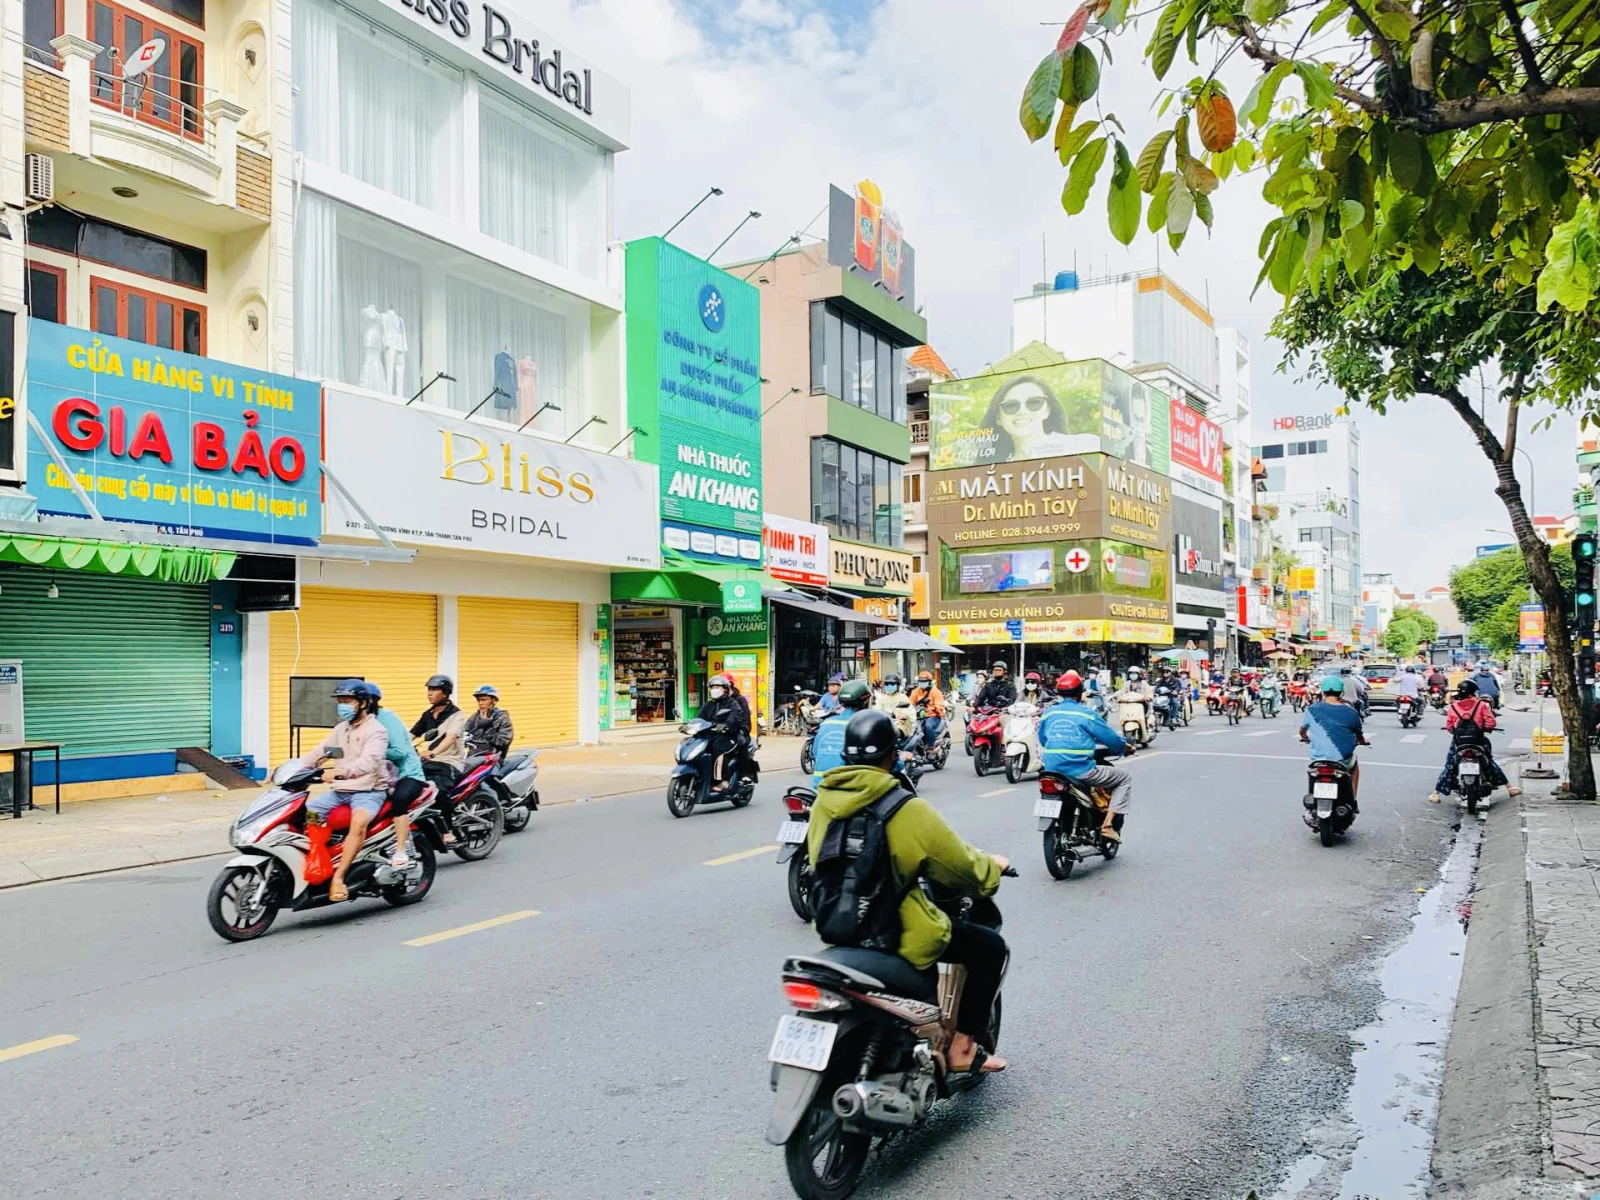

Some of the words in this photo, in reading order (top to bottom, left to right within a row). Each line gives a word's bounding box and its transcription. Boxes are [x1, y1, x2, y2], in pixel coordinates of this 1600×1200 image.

[482, 3, 593, 115] Bridal
[67, 340, 125, 378] CỬA
[133, 356, 203, 393] HÀNG
[211, 375, 234, 399] VI
[242, 378, 293, 411] TÍNH
[1273, 412, 1334, 431] HDBank
[52, 397, 174, 465] GIA
[193, 409, 306, 483] BẢO
[1199, 420, 1224, 476] 0%
[438, 428, 595, 504] Bliss
[677, 444, 707, 468] NHÀ
[707, 452, 751, 478] THUỐC
[130, 473, 150, 502] cấp
[153, 479, 177, 505] máy
[231, 488, 255, 511] thiết
[258, 492, 267, 517] bị
[667, 470, 699, 501] AN
[697, 477, 760, 513] KHANG
[960, 463, 1014, 500] MẮT
[1021, 465, 1084, 494] KÍNH
[1108, 460, 1135, 496] MẮT
[1137, 473, 1162, 505] KÍNH
[471, 509, 568, 540] BRIDAL
[963, 504, 986, 523] Dr.
[990, 500, 1036, 520] Minh
[1041, 496, 1079, 518] Tây
[175, 526, 189, 535] TÂN
[189, 527, 204, 537] PHÚ
[954, 528, 999, 541] HOTLINE:
[1002, 522, 1081, 538] 028.3944.9999
[1582, 542, 1593, 556] 9
[723, 623, 736, 632] AN
[737, 621, 767, 632] KHANG
[727, 615, 740, 623] NHÀ
[740, 614, 763, 622] THUỐC
[938, 606, 986, 620] CHUYÊN
[989, 608, 1011, 619] GIA
[1014, 602, 1041, 618] KÍNH
[1046, 602, 1064, 618] ĐỘ
[220, 623, 234, 632] 319
